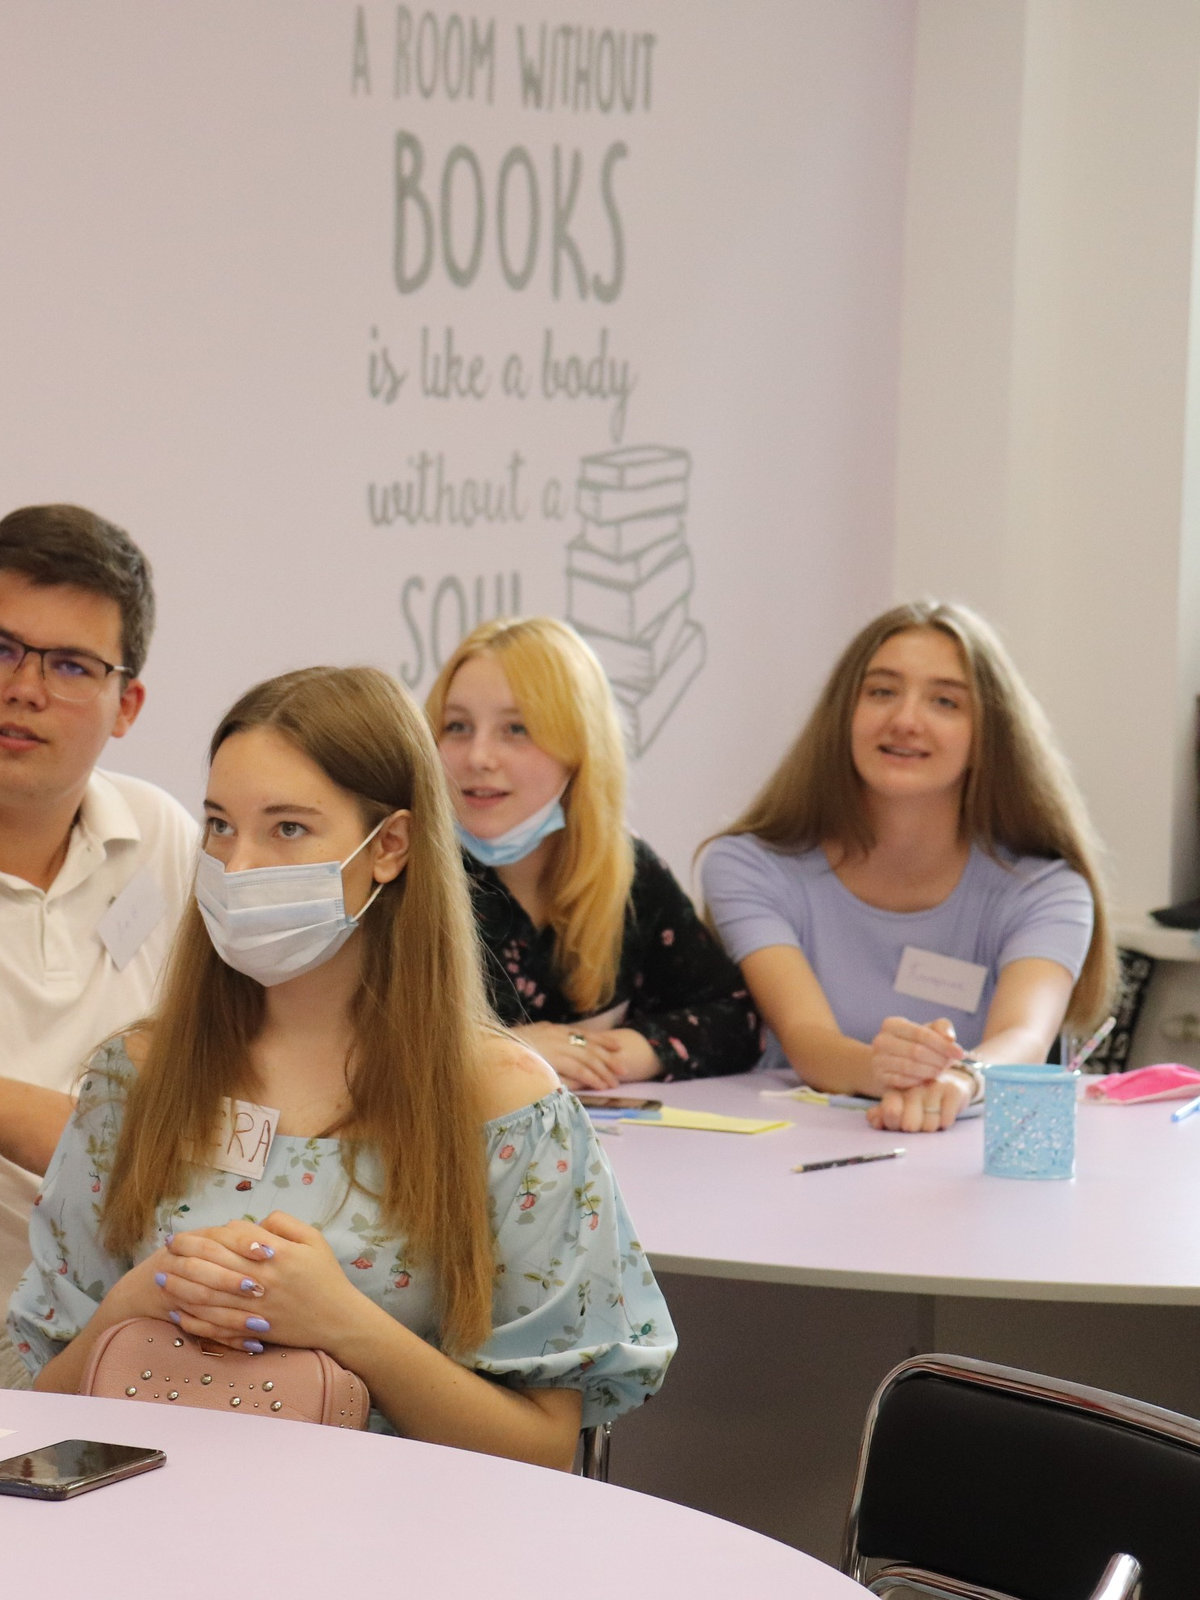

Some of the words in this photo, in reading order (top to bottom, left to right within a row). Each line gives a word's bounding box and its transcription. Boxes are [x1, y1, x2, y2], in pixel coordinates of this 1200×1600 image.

[351, 4, 372, 96] A
[394, 6, 496, 106] ROOM
[516, 21, 657, 113] WITHOUT
[393, 129, 629, 303] BOOKS
[367, 324, 407, 404] is
[419, 325, 492, 399] like
[502, 353, 532, 399] a
[541, 326, 638, 444] body
[367, 450, 526, 527] without
[541, 477, 565, 521] a
